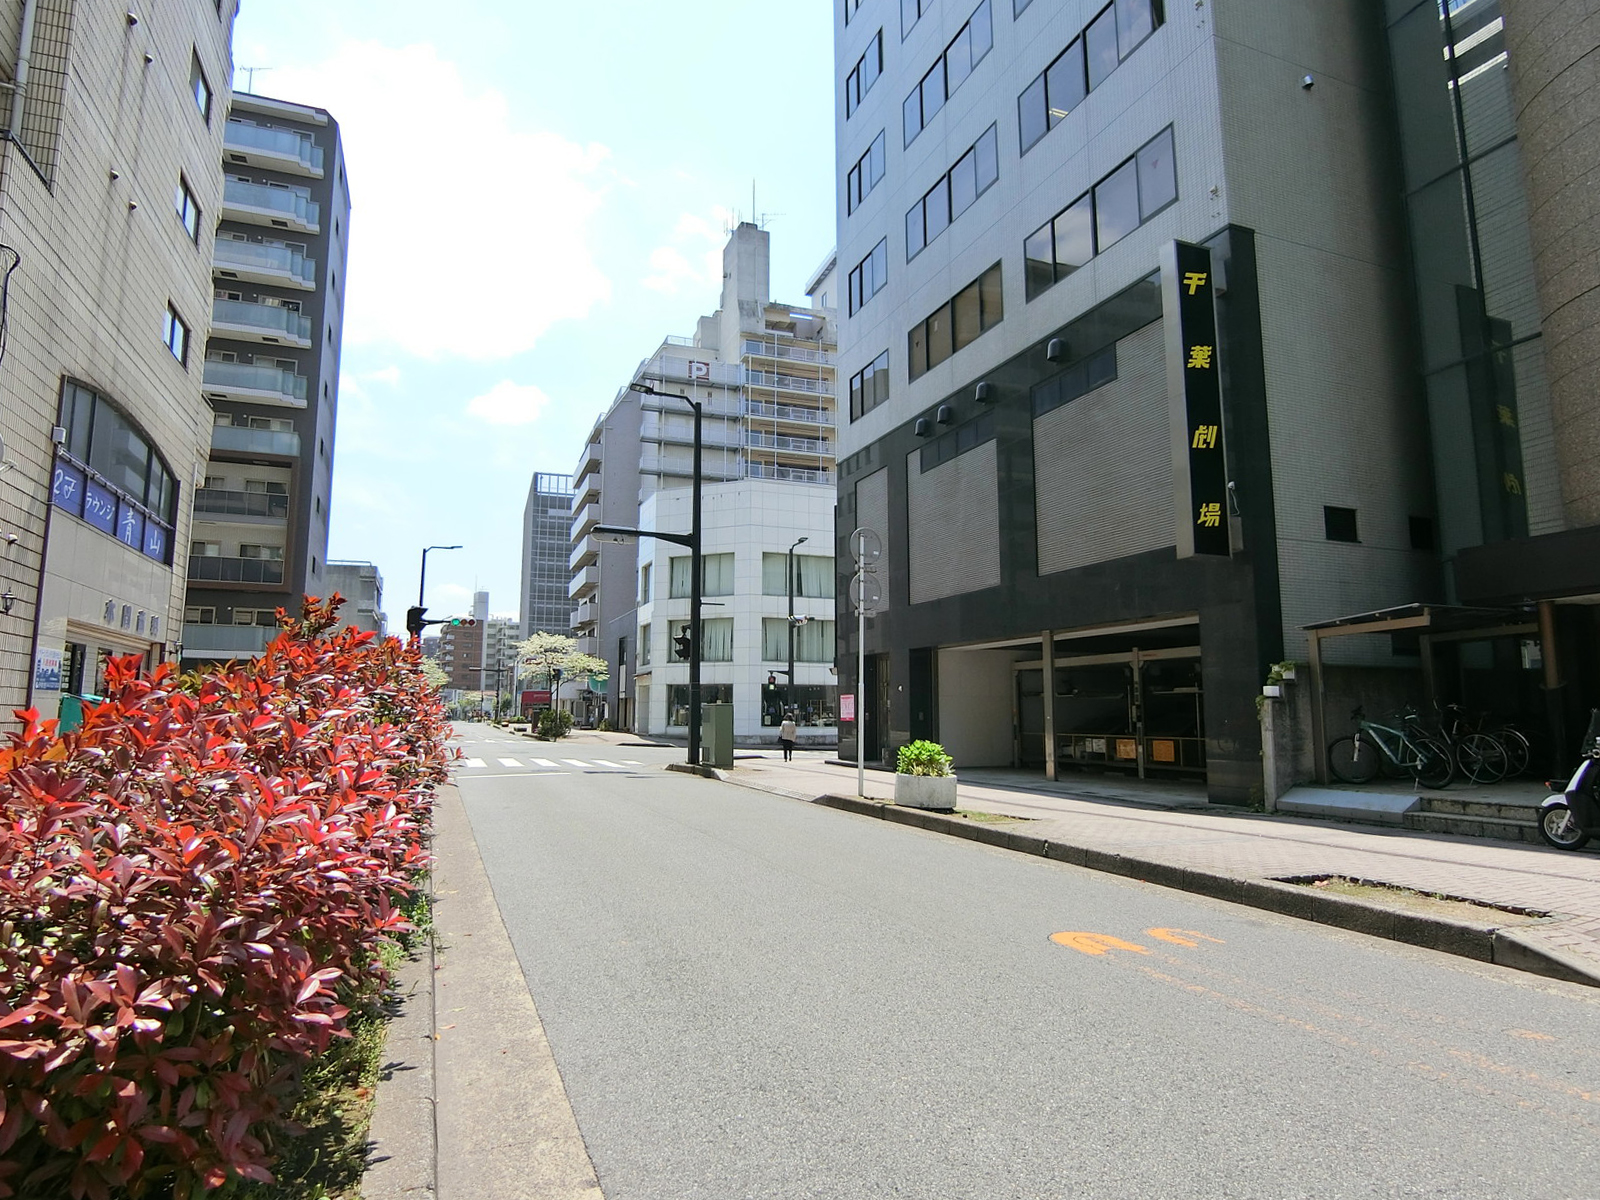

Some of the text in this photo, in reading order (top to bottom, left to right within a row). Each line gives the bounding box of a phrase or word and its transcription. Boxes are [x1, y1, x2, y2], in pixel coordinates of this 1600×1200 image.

[691, 362, 708, 379] P
[1182, 271, 1222, 528] 千葉劇場
[85, 492, 116, 521] ラウンジ
[121, 507, 161, 555] 青山
